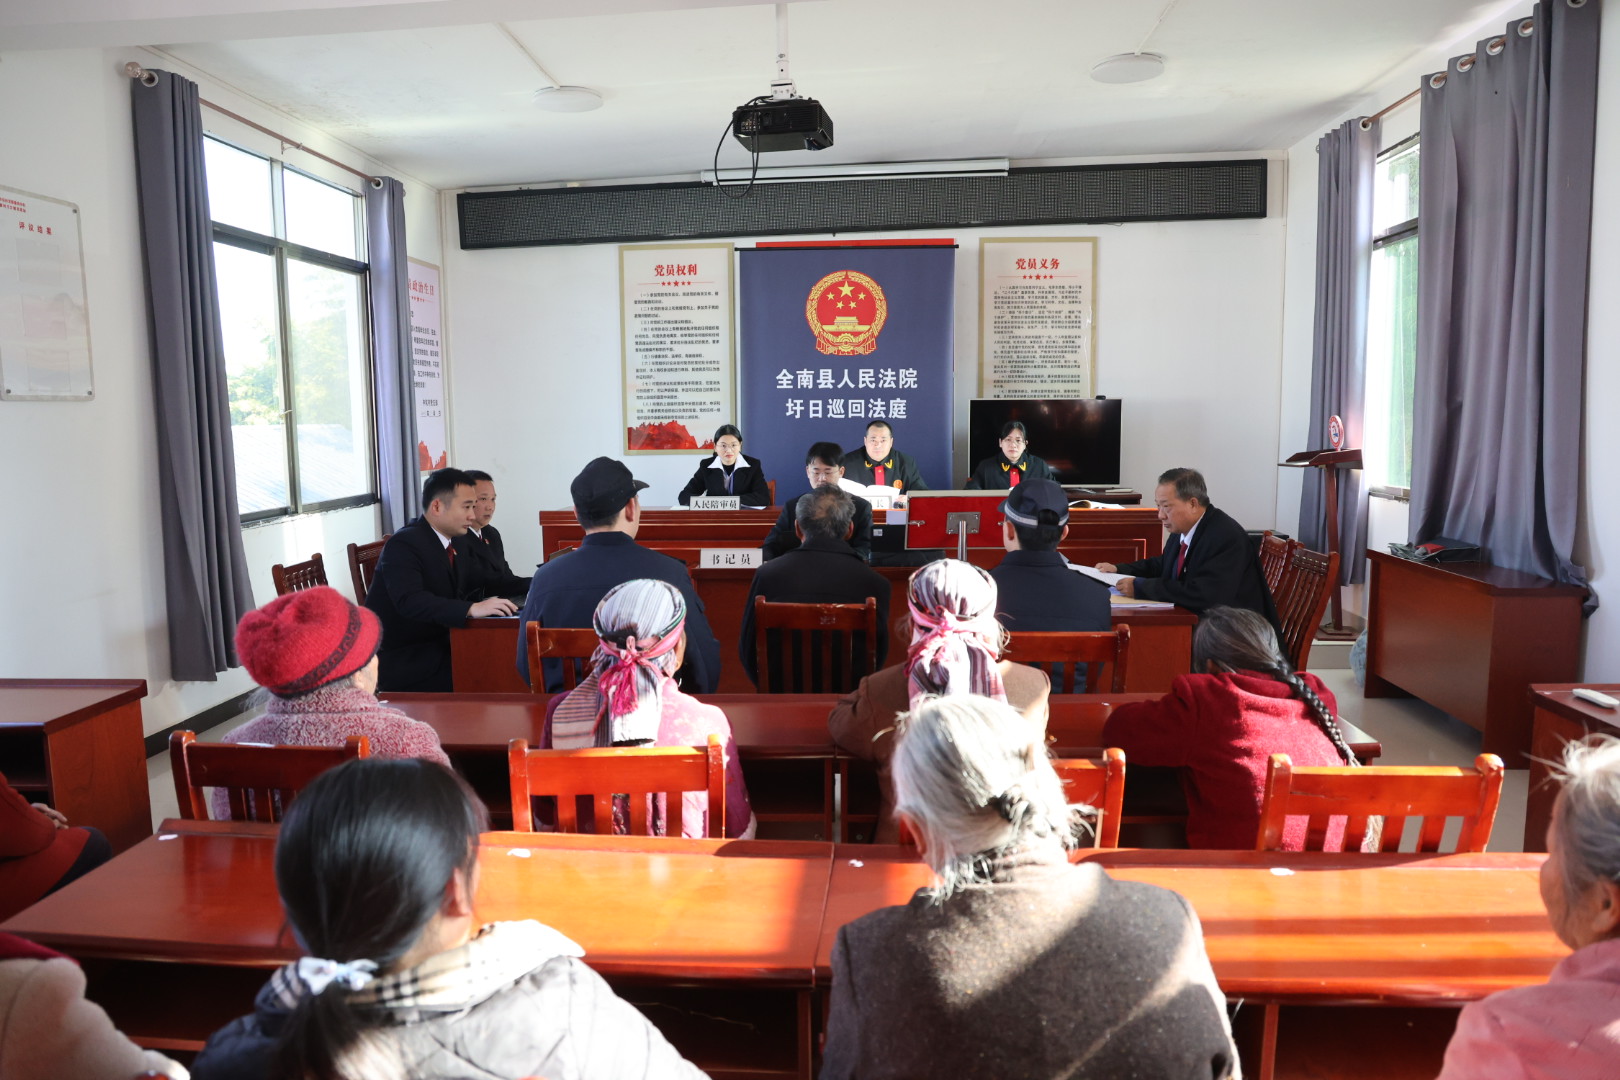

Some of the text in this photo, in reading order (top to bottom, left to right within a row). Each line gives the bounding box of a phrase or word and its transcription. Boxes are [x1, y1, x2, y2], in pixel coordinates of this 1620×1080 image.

[654, 264, 698, 276] 党员权利
[1016, 258, 1060, 270] 党员义务
[776, 368, 918, 389] 全南县人民法院
[786, 398, 908, 419] 圩日巡回法庭
[693, 500, 738, 510] 人民陪审员
[712, 553, 751, 565] 书记员
